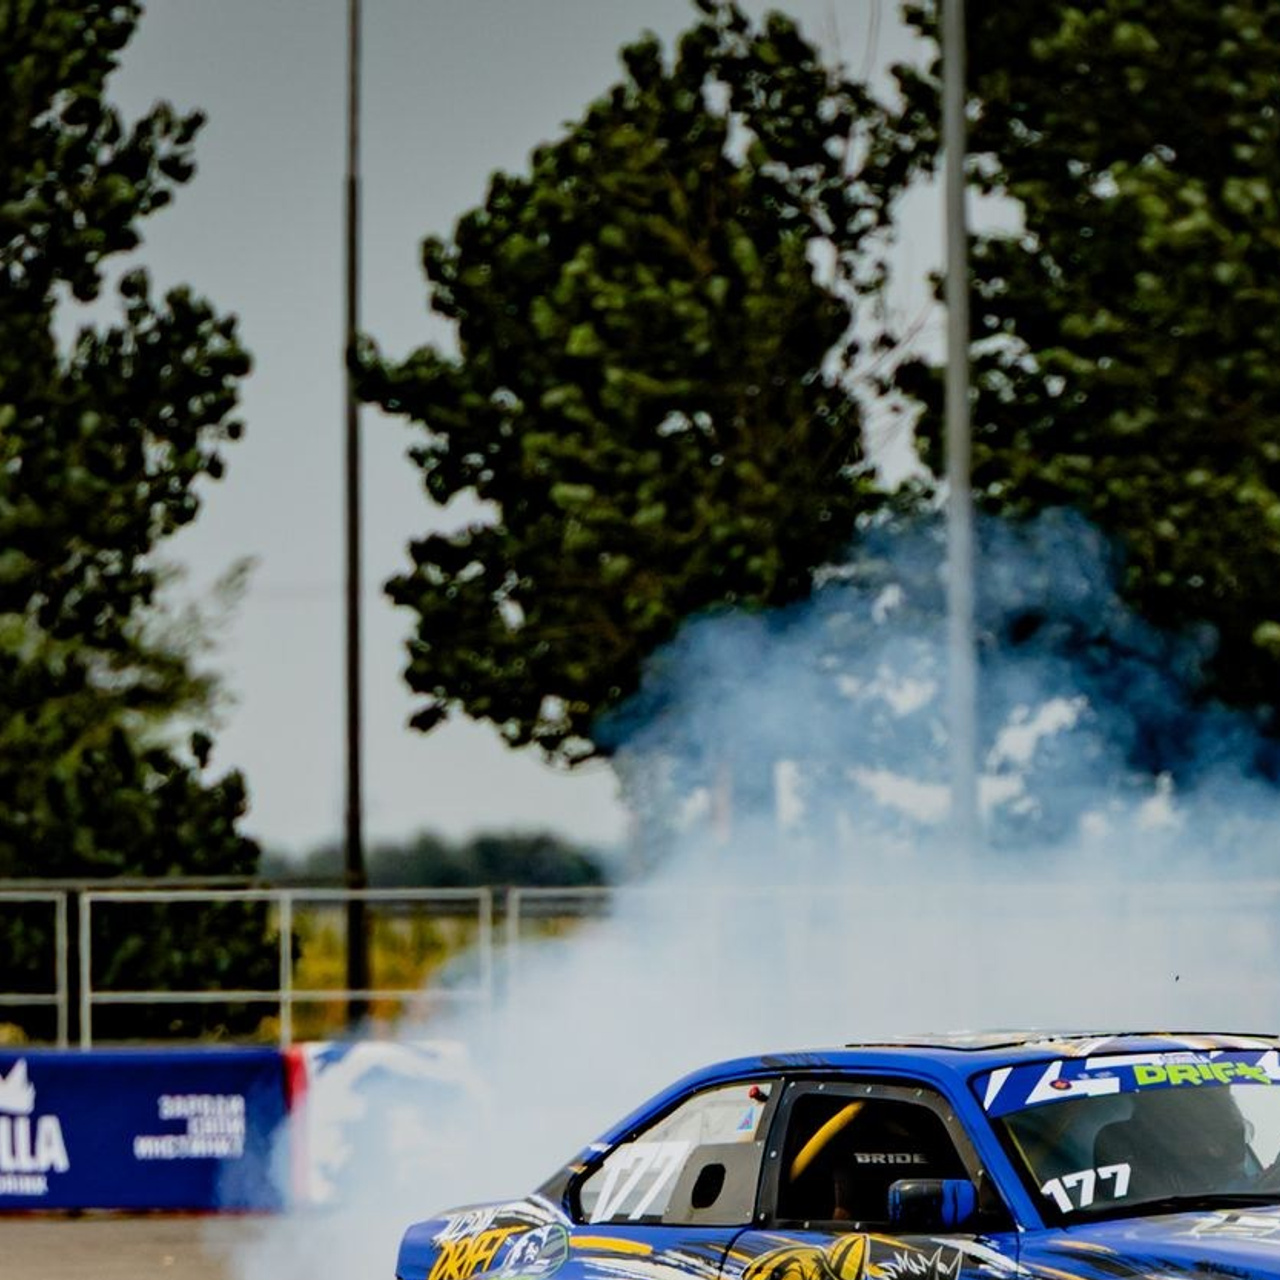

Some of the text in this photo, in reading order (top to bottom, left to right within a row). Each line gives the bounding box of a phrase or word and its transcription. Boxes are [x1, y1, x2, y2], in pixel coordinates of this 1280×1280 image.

[1133, 1062, 1272, 1086] DRIFT
[853, 1152, 929, 1164] BRIDE
[588, 1142, 694, 1224] 177
[1040, 1162, 1131, 1214] 177
